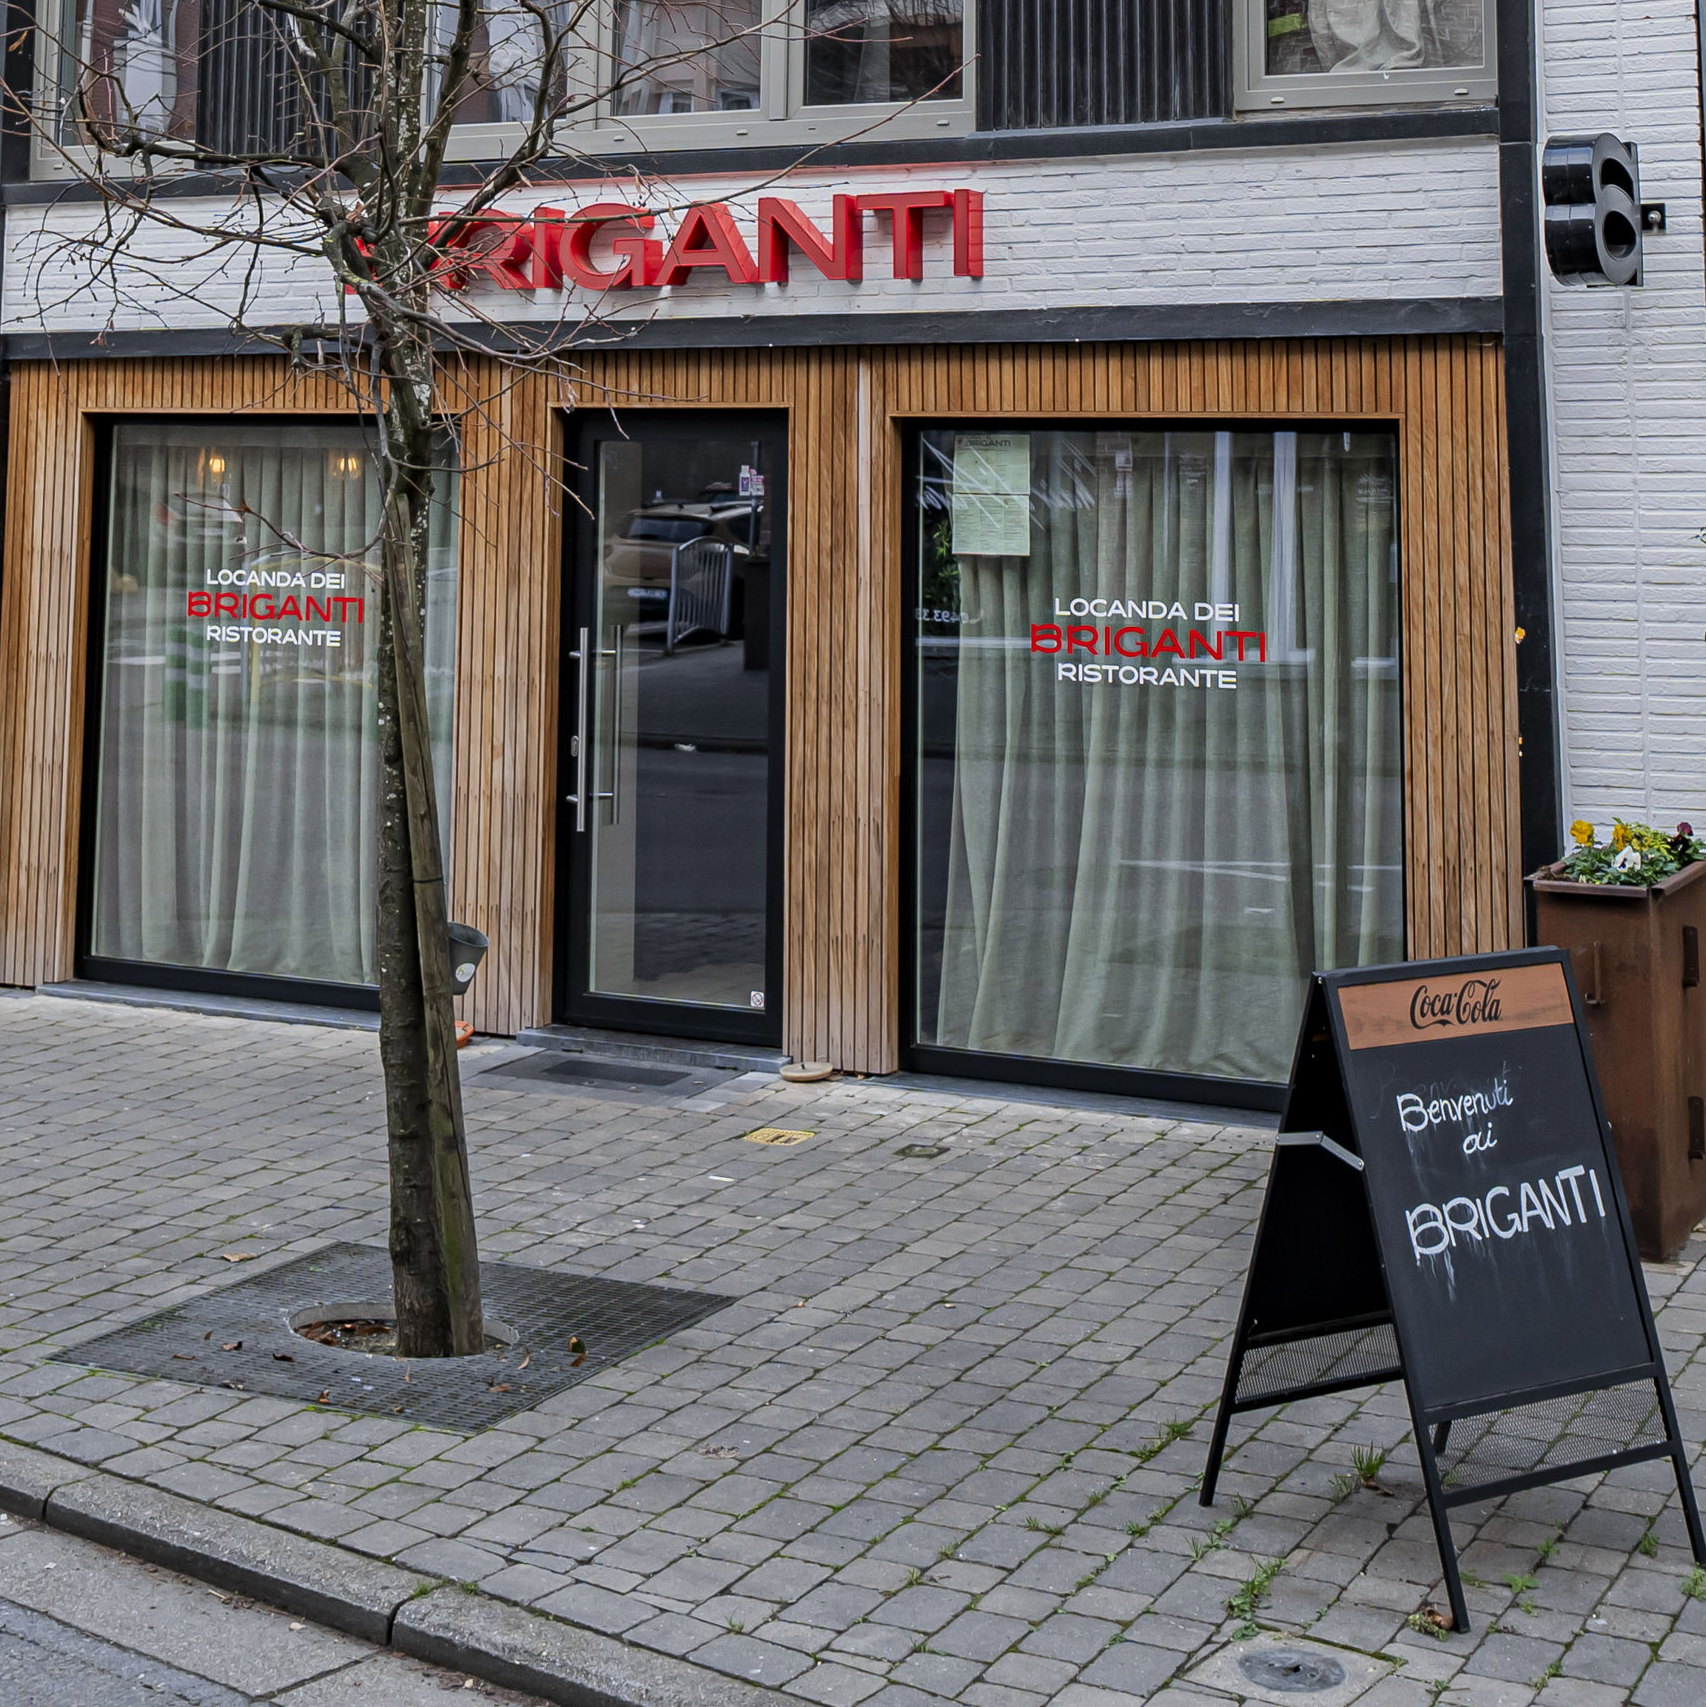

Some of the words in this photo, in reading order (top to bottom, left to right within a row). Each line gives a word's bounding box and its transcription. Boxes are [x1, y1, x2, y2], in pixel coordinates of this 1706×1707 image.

[343, 188, 985, 297] RIGANTI
[206, 568, 306, 588] LOCANDA
[310, 571, 346, 590] DEI
[187, 590, 364, 624] BRIGANTI
[1054, 597, 1188, 621] LOCANDA
[1194, 602, 1240, 622] DEI
[206, 625, 342, 647] RISTORANTE
[1030, 623, 1266, 662] BRIGANTI
[1057, 662, 1237, 689] RISTORANTE
[1409, 978, 1503, 1030] Coca-Cola
[1396, 1077, 1514, 1132] Benvenuti
[1462, 1122, 1498, 1155] ai
[1405, 1164, 1606, 1262] BRIGANTI
